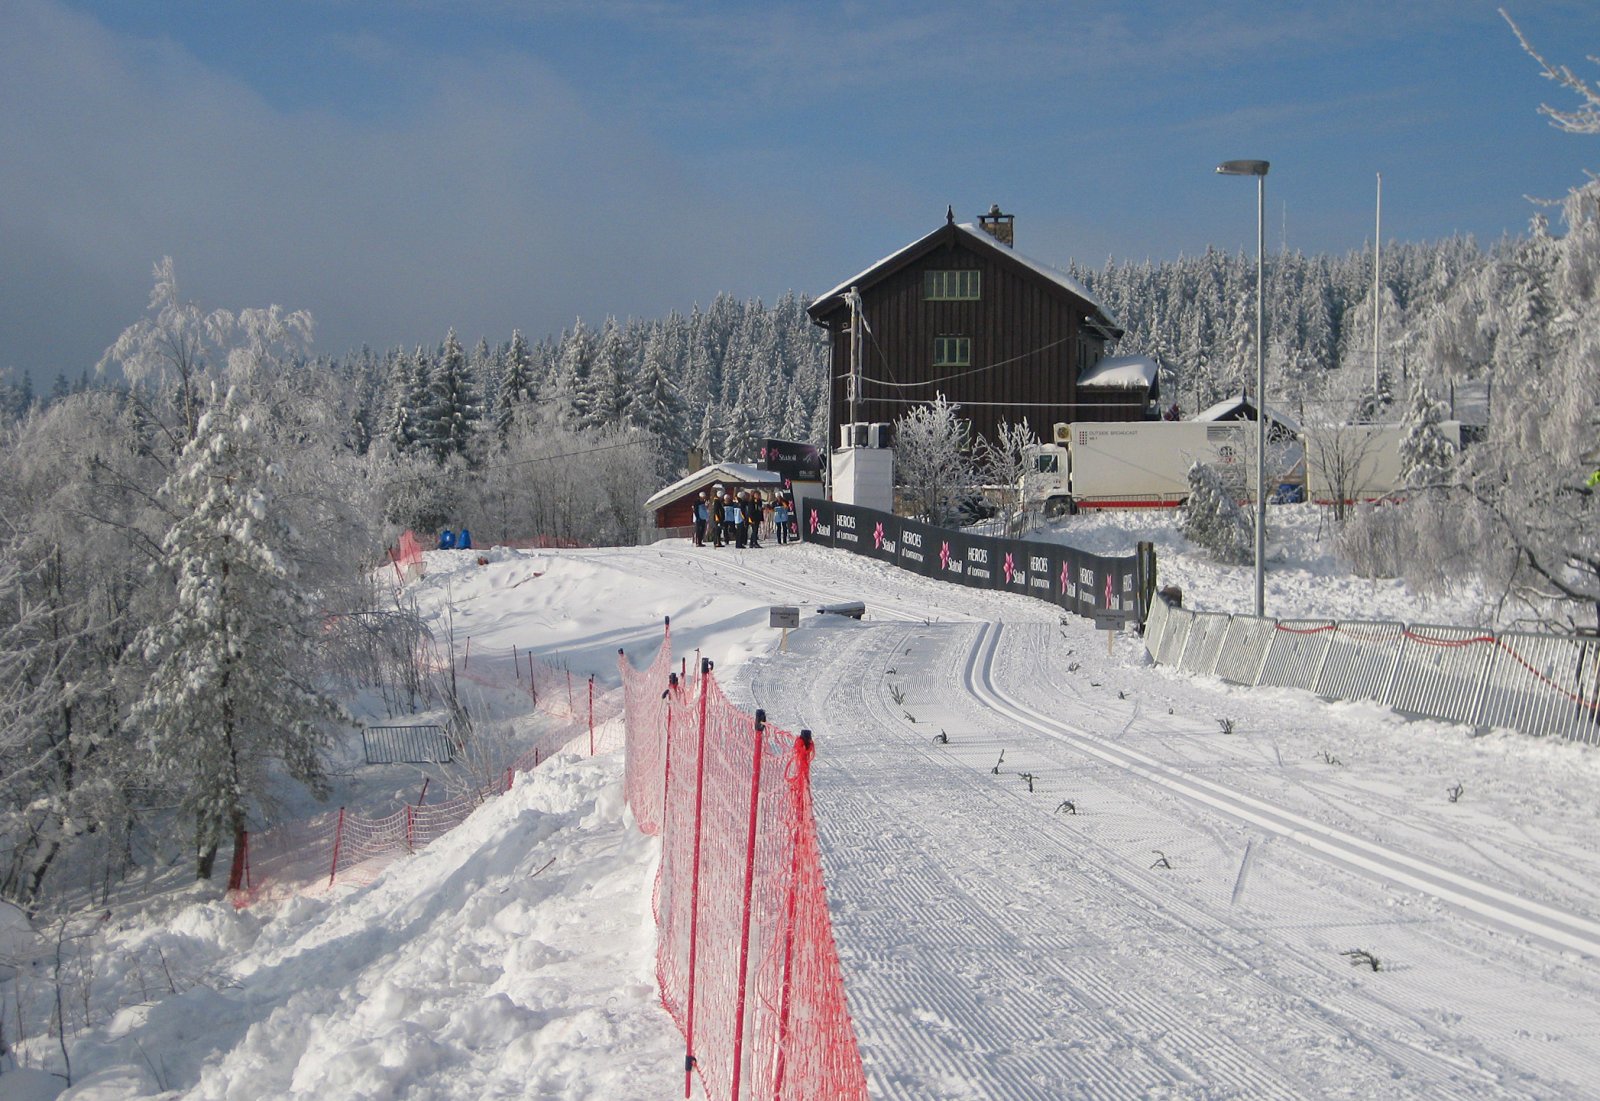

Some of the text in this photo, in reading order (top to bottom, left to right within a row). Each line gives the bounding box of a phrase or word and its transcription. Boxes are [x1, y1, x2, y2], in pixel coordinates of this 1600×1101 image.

[816, 522, 831, 537] Statoil
[836, 514, 856, 529] HEROES
[882, 537, 896, 553] Statoil
[902, 530, 922, 548] HEROES
[967, 547, 988, 564] HEROES
[948, 557, 963, 573] Statoil
[1030, 556, 1048, 573] HEROES
